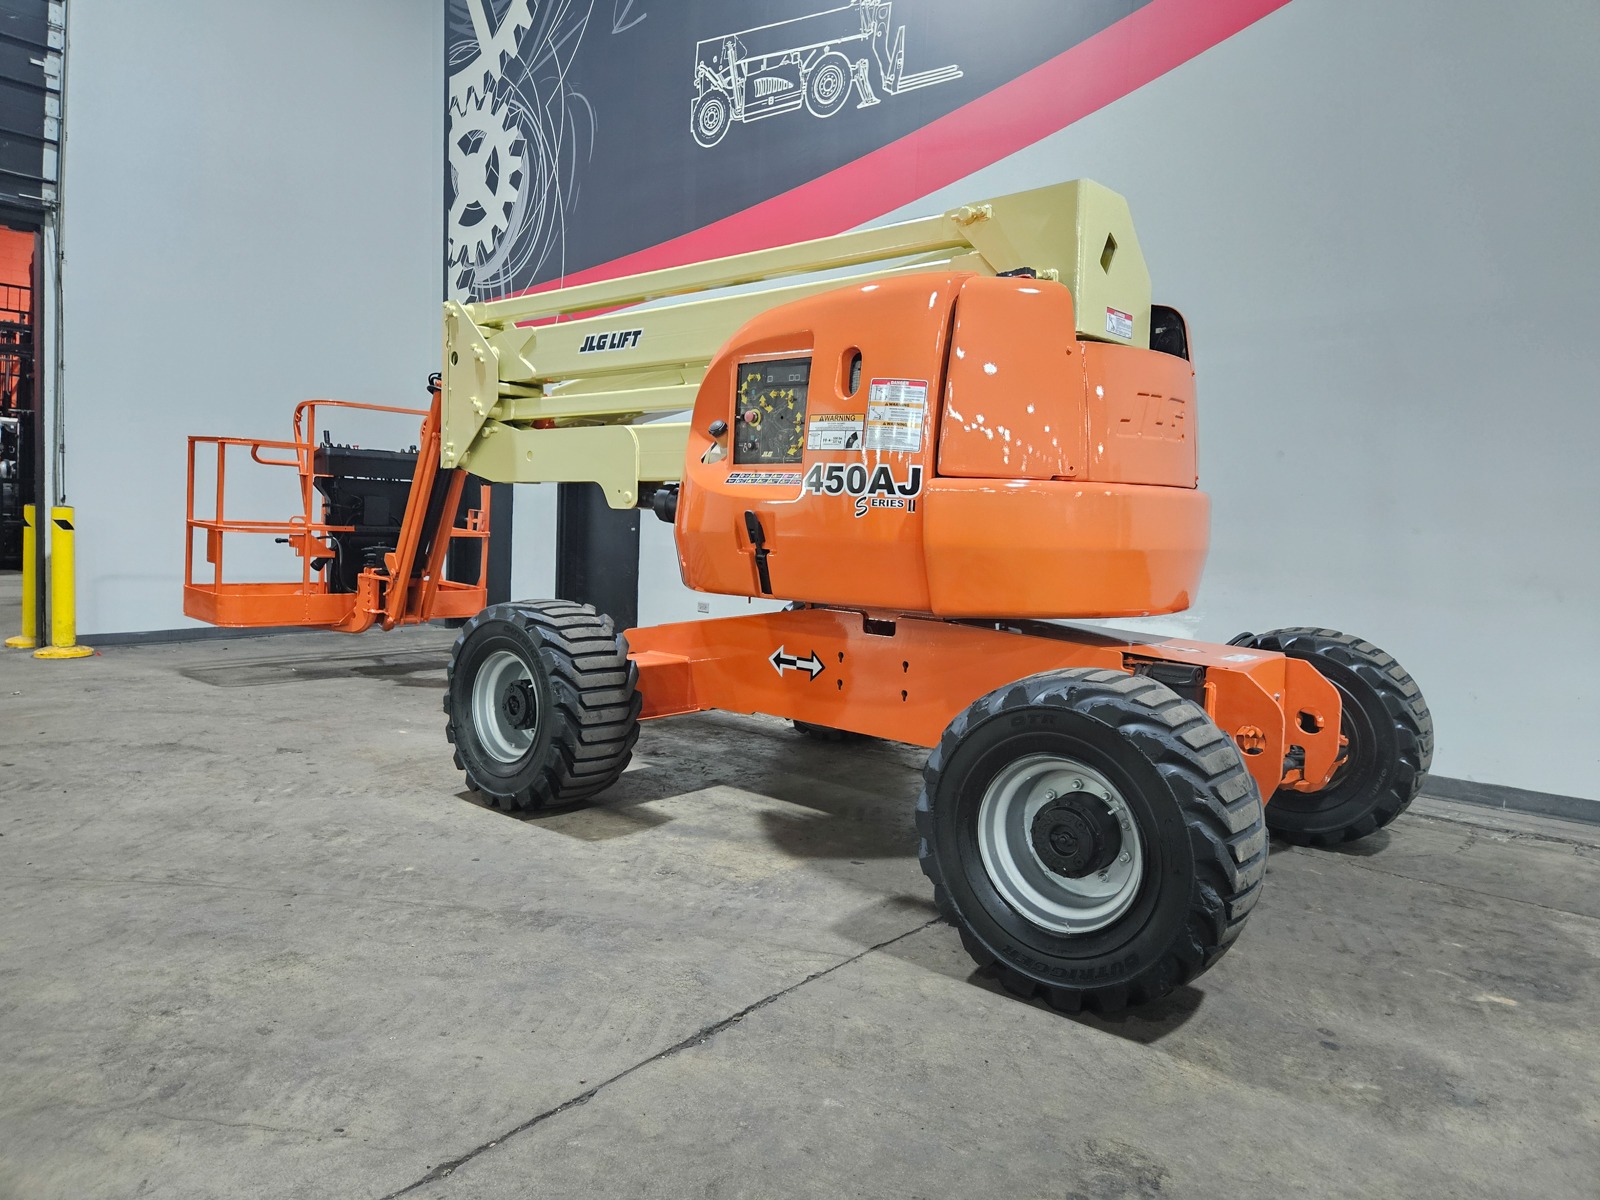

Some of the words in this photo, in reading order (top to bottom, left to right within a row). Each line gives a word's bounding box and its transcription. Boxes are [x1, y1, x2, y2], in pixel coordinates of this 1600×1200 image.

[579, 333, 608, 352] JLG
[609, 330, 642, 349] LIFT
[824, 414, 856, 422] WARNING
[805, 464, 922, 497] 450AJ
[855, 496, 904, 517] SERIES
[1001, 944, 1140, 980] OUTRIGGER
